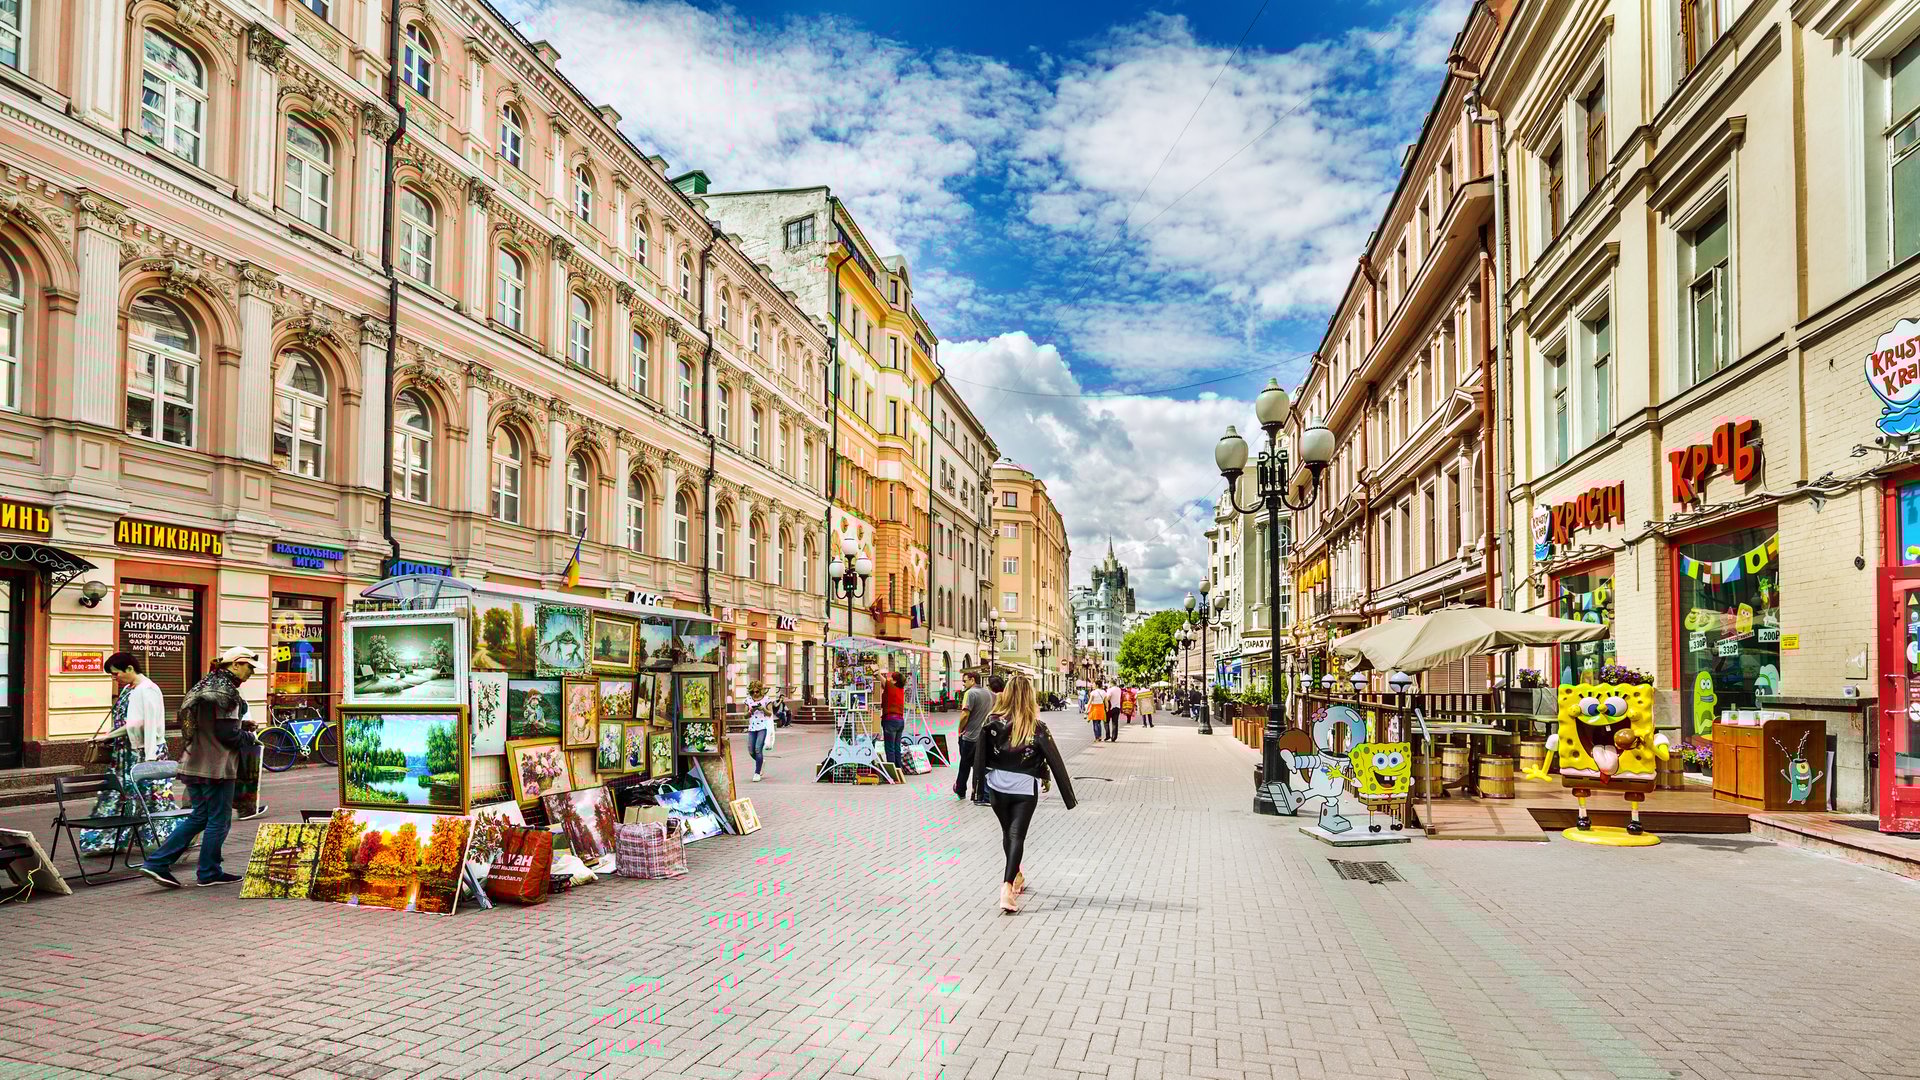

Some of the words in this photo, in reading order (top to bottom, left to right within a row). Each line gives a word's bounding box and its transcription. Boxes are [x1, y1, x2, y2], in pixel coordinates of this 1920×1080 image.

[118, 520, 222, 555] АНТИКВАРЪ
[276, 543, 344, 560] НАСТОЛЬНЫЕ
[296, 557, 324, 568] ИГРЫ
[633, 591, 664, 607] KFC
[136, 602, 180, 613] ОЦЕНКА
[131, 612, 183, 623] ПОКУПКА
[123, 621, 190, 631] АНТИКВАРИАТ
[780, 615, 798, 633] KFC
[154, 633, 186, 641] КАРТИНЫ
